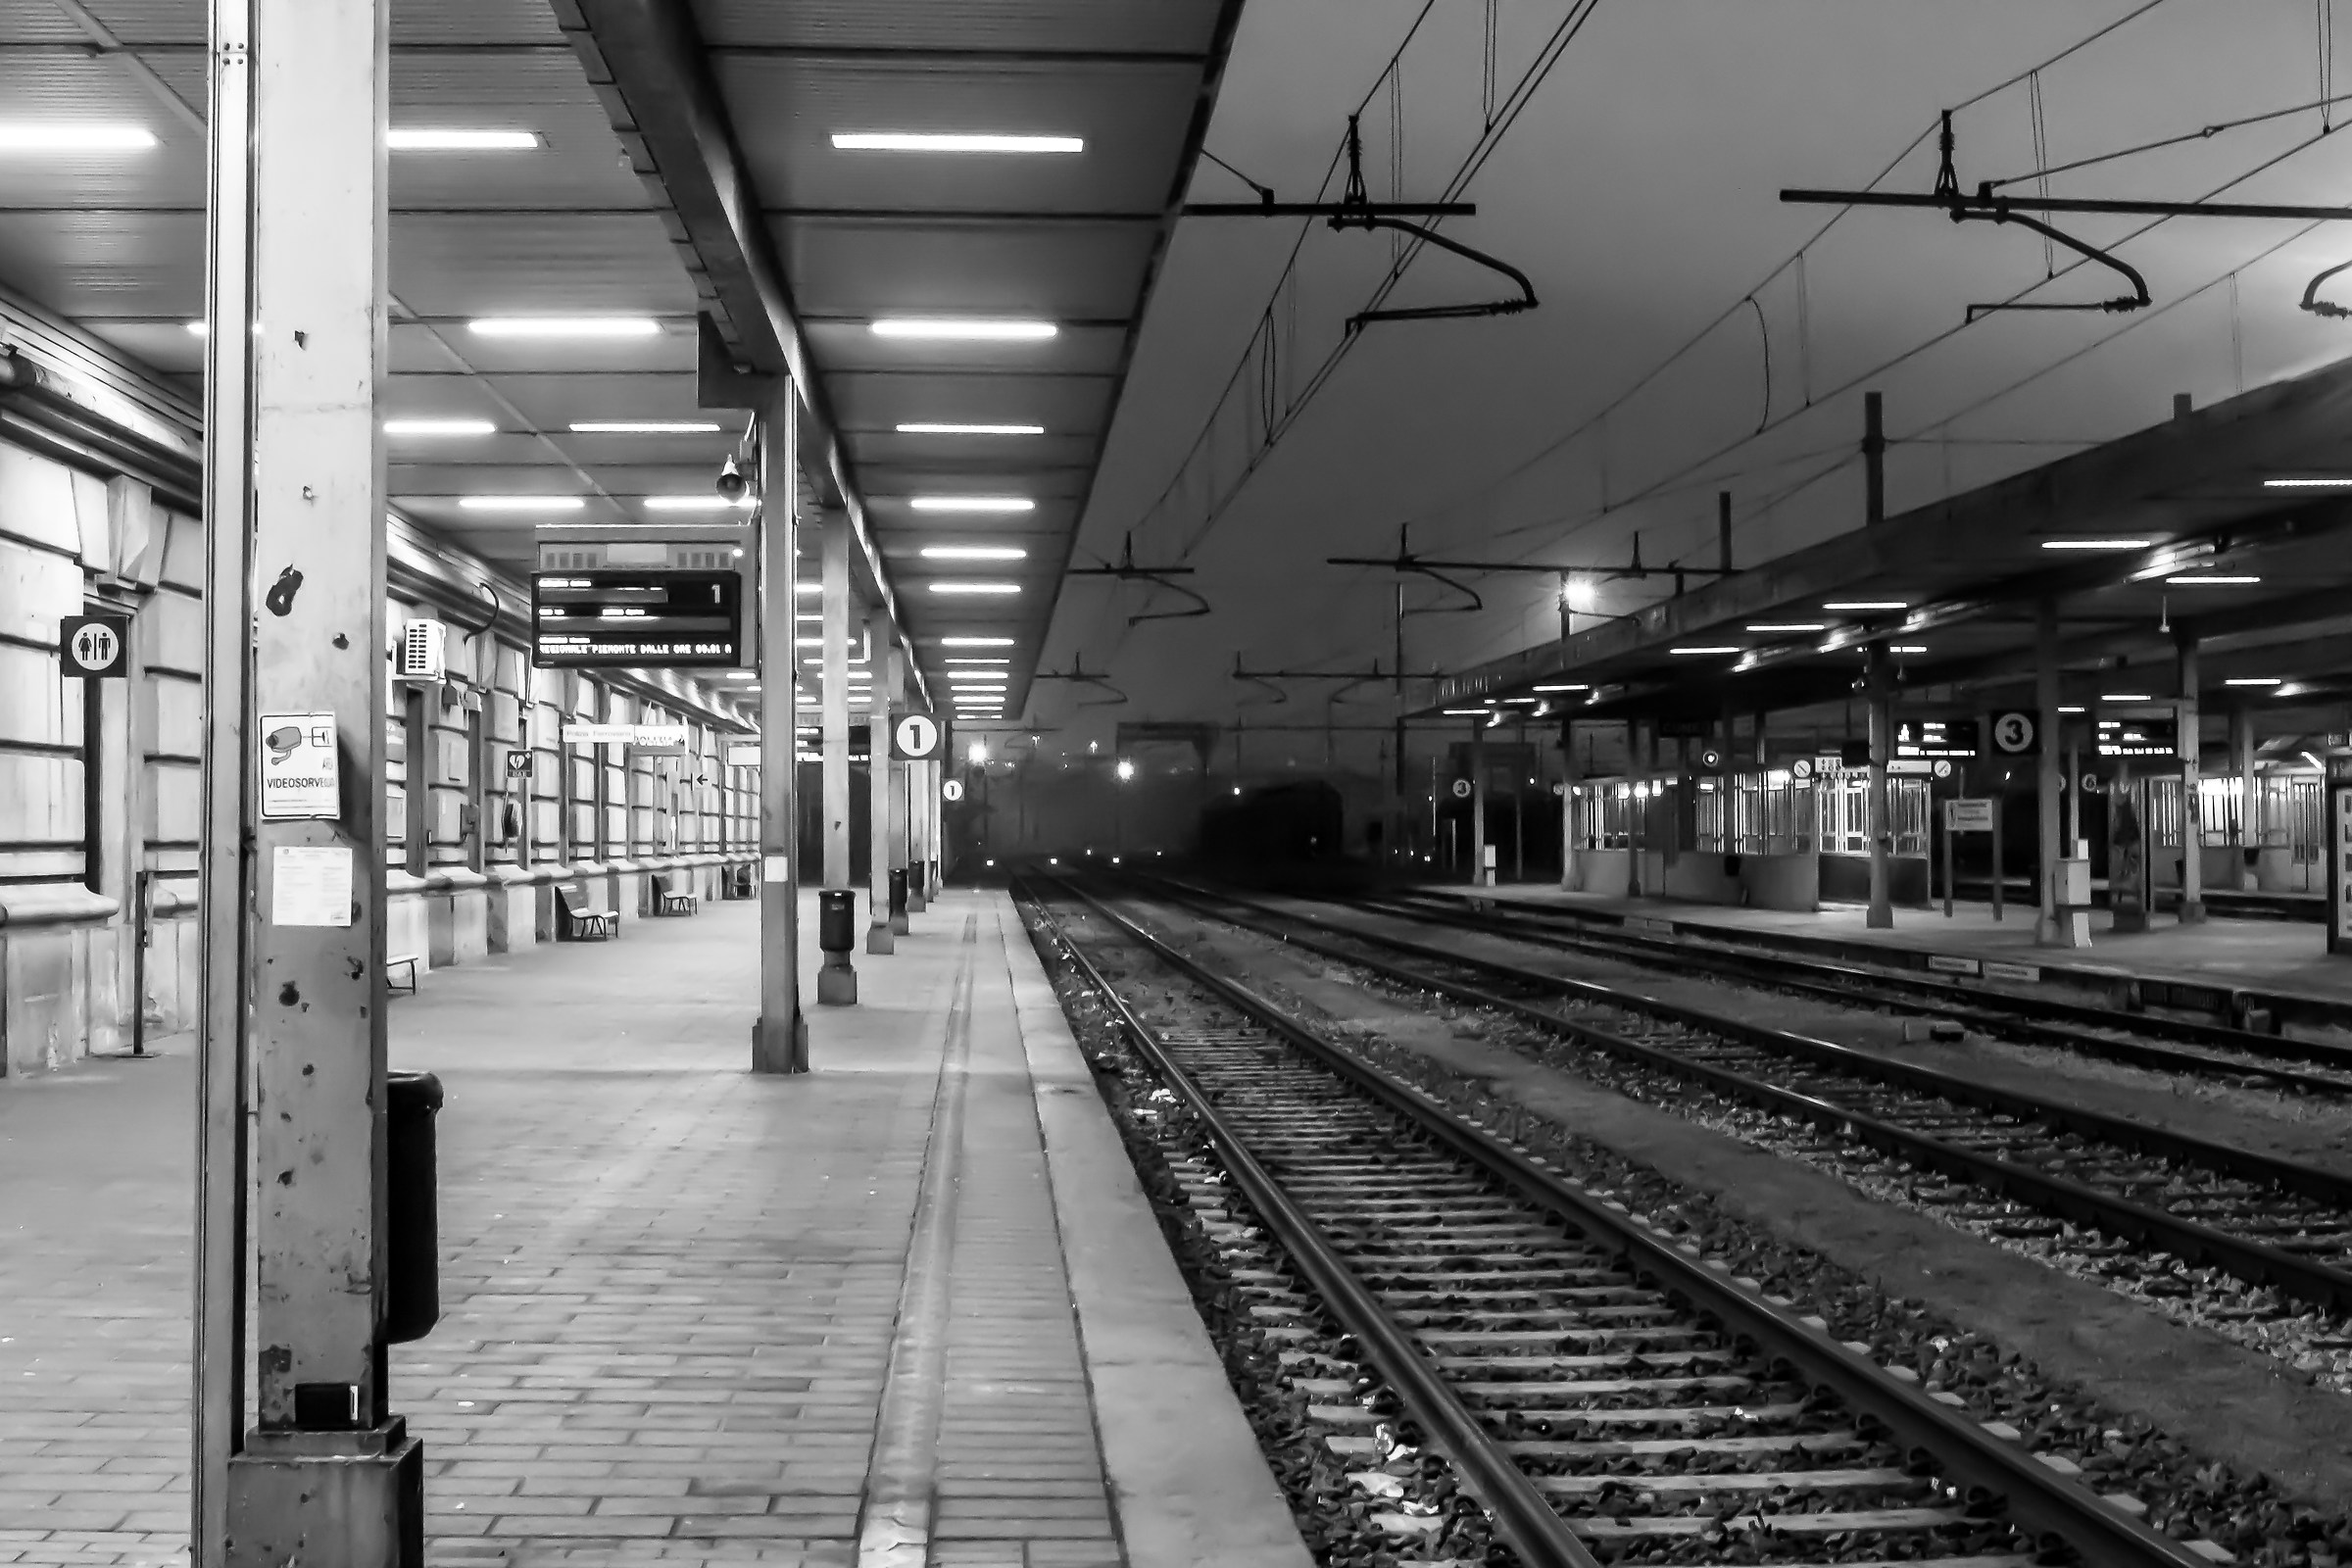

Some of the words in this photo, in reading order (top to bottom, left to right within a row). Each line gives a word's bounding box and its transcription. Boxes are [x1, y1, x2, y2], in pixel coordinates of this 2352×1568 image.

[711, 584, 721, 604] 1
[591, 644, 636, 655] PIEMONTE
[640, 644, 669, 655] DALLE
[673, 644, 692, 655] ORE
[909, 724, 921, 750] 1
[2004, 719, 2025, 746] 3
